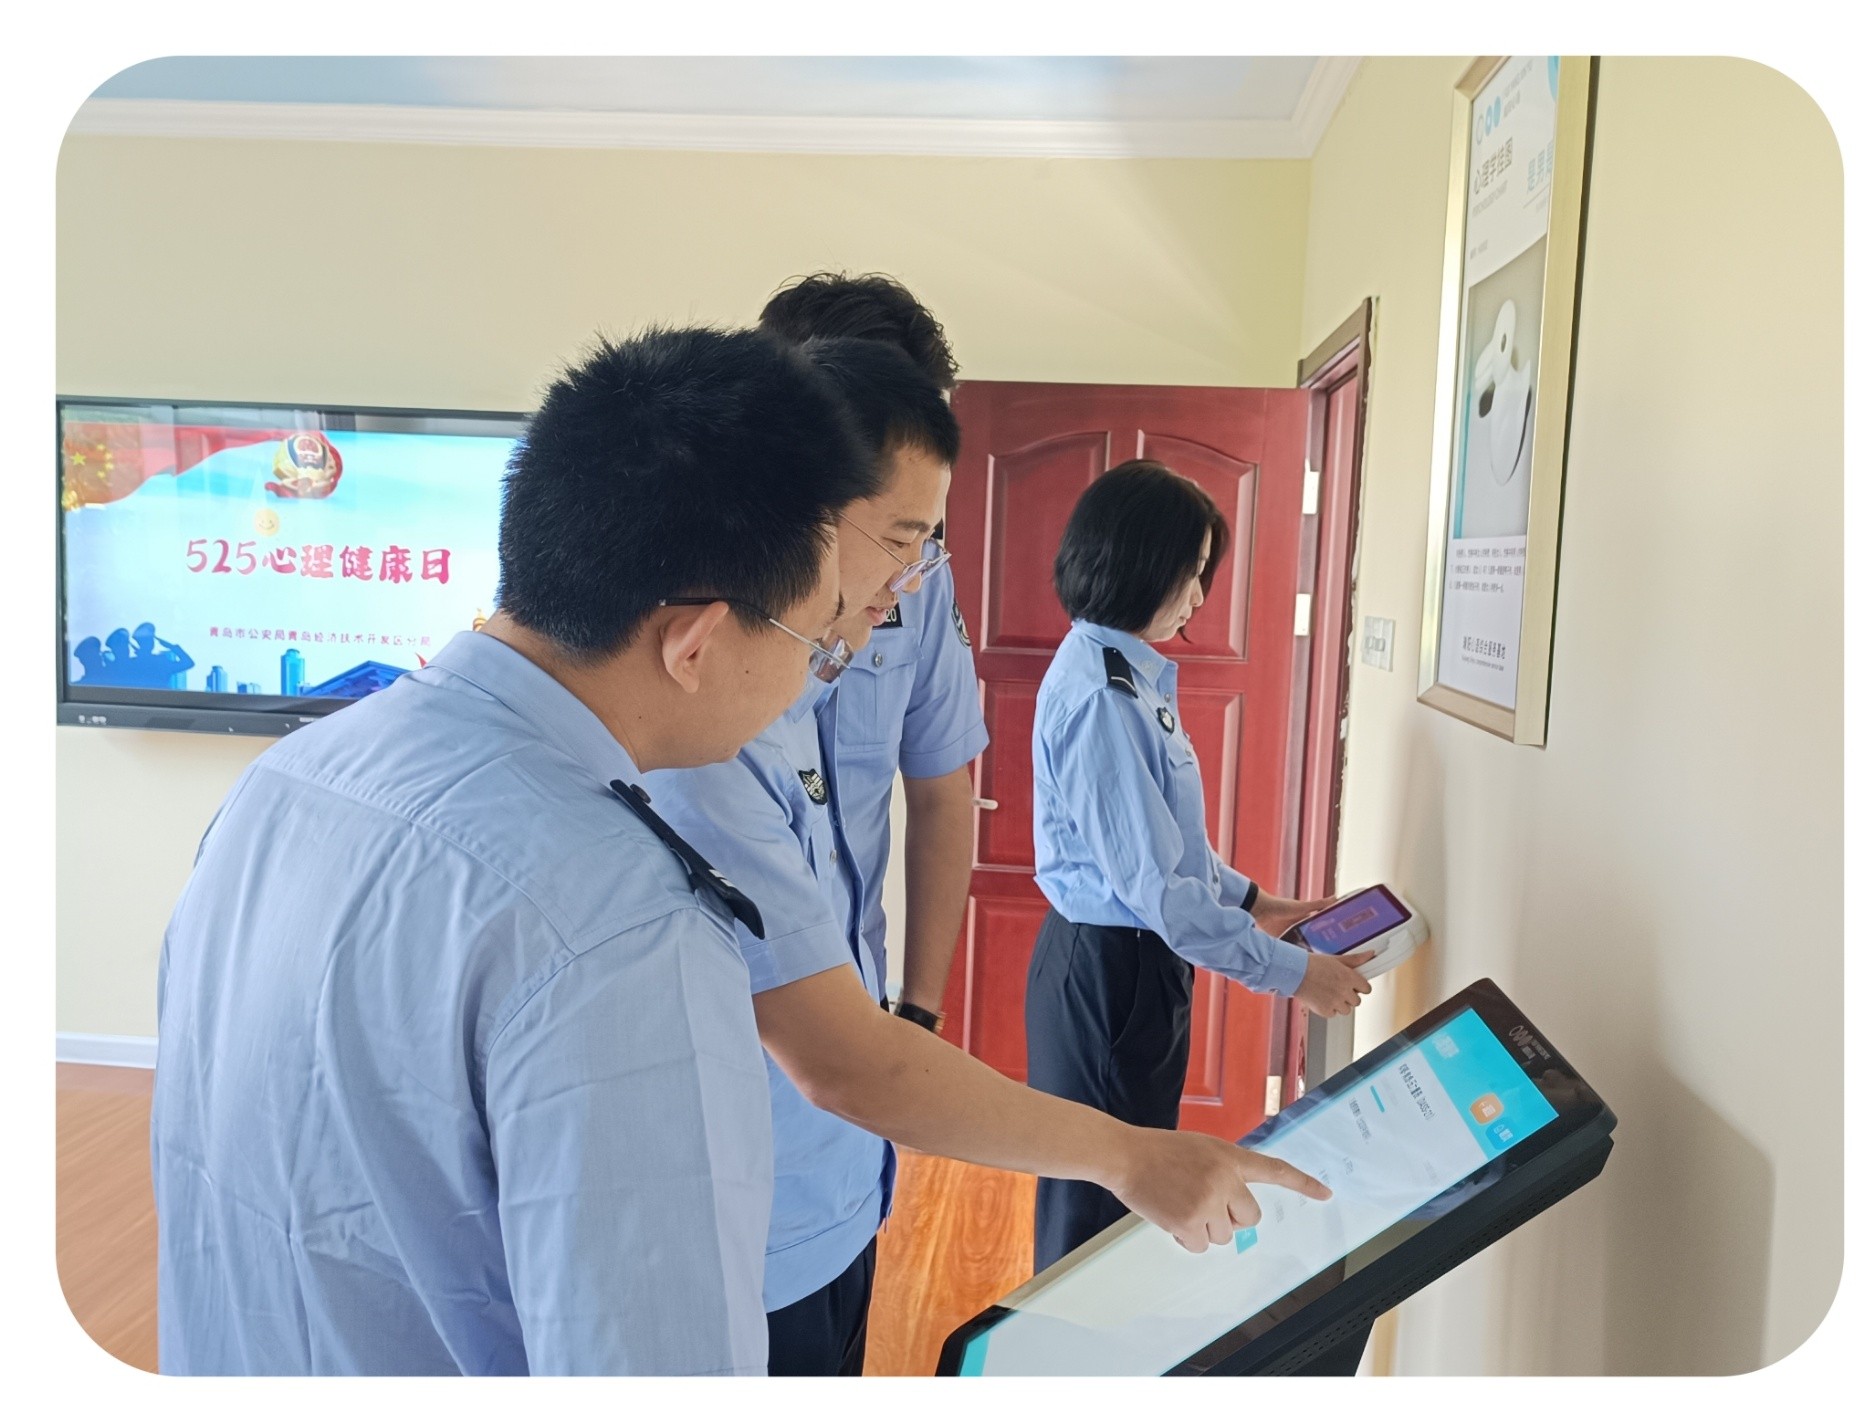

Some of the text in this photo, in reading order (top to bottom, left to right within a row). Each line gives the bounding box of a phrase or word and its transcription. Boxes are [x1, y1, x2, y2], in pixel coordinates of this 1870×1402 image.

[186, 538, 452, 584] 525心理健康日
[209, 626, 431, 648] 青岛市公安局青岛经济技术开发区分局
